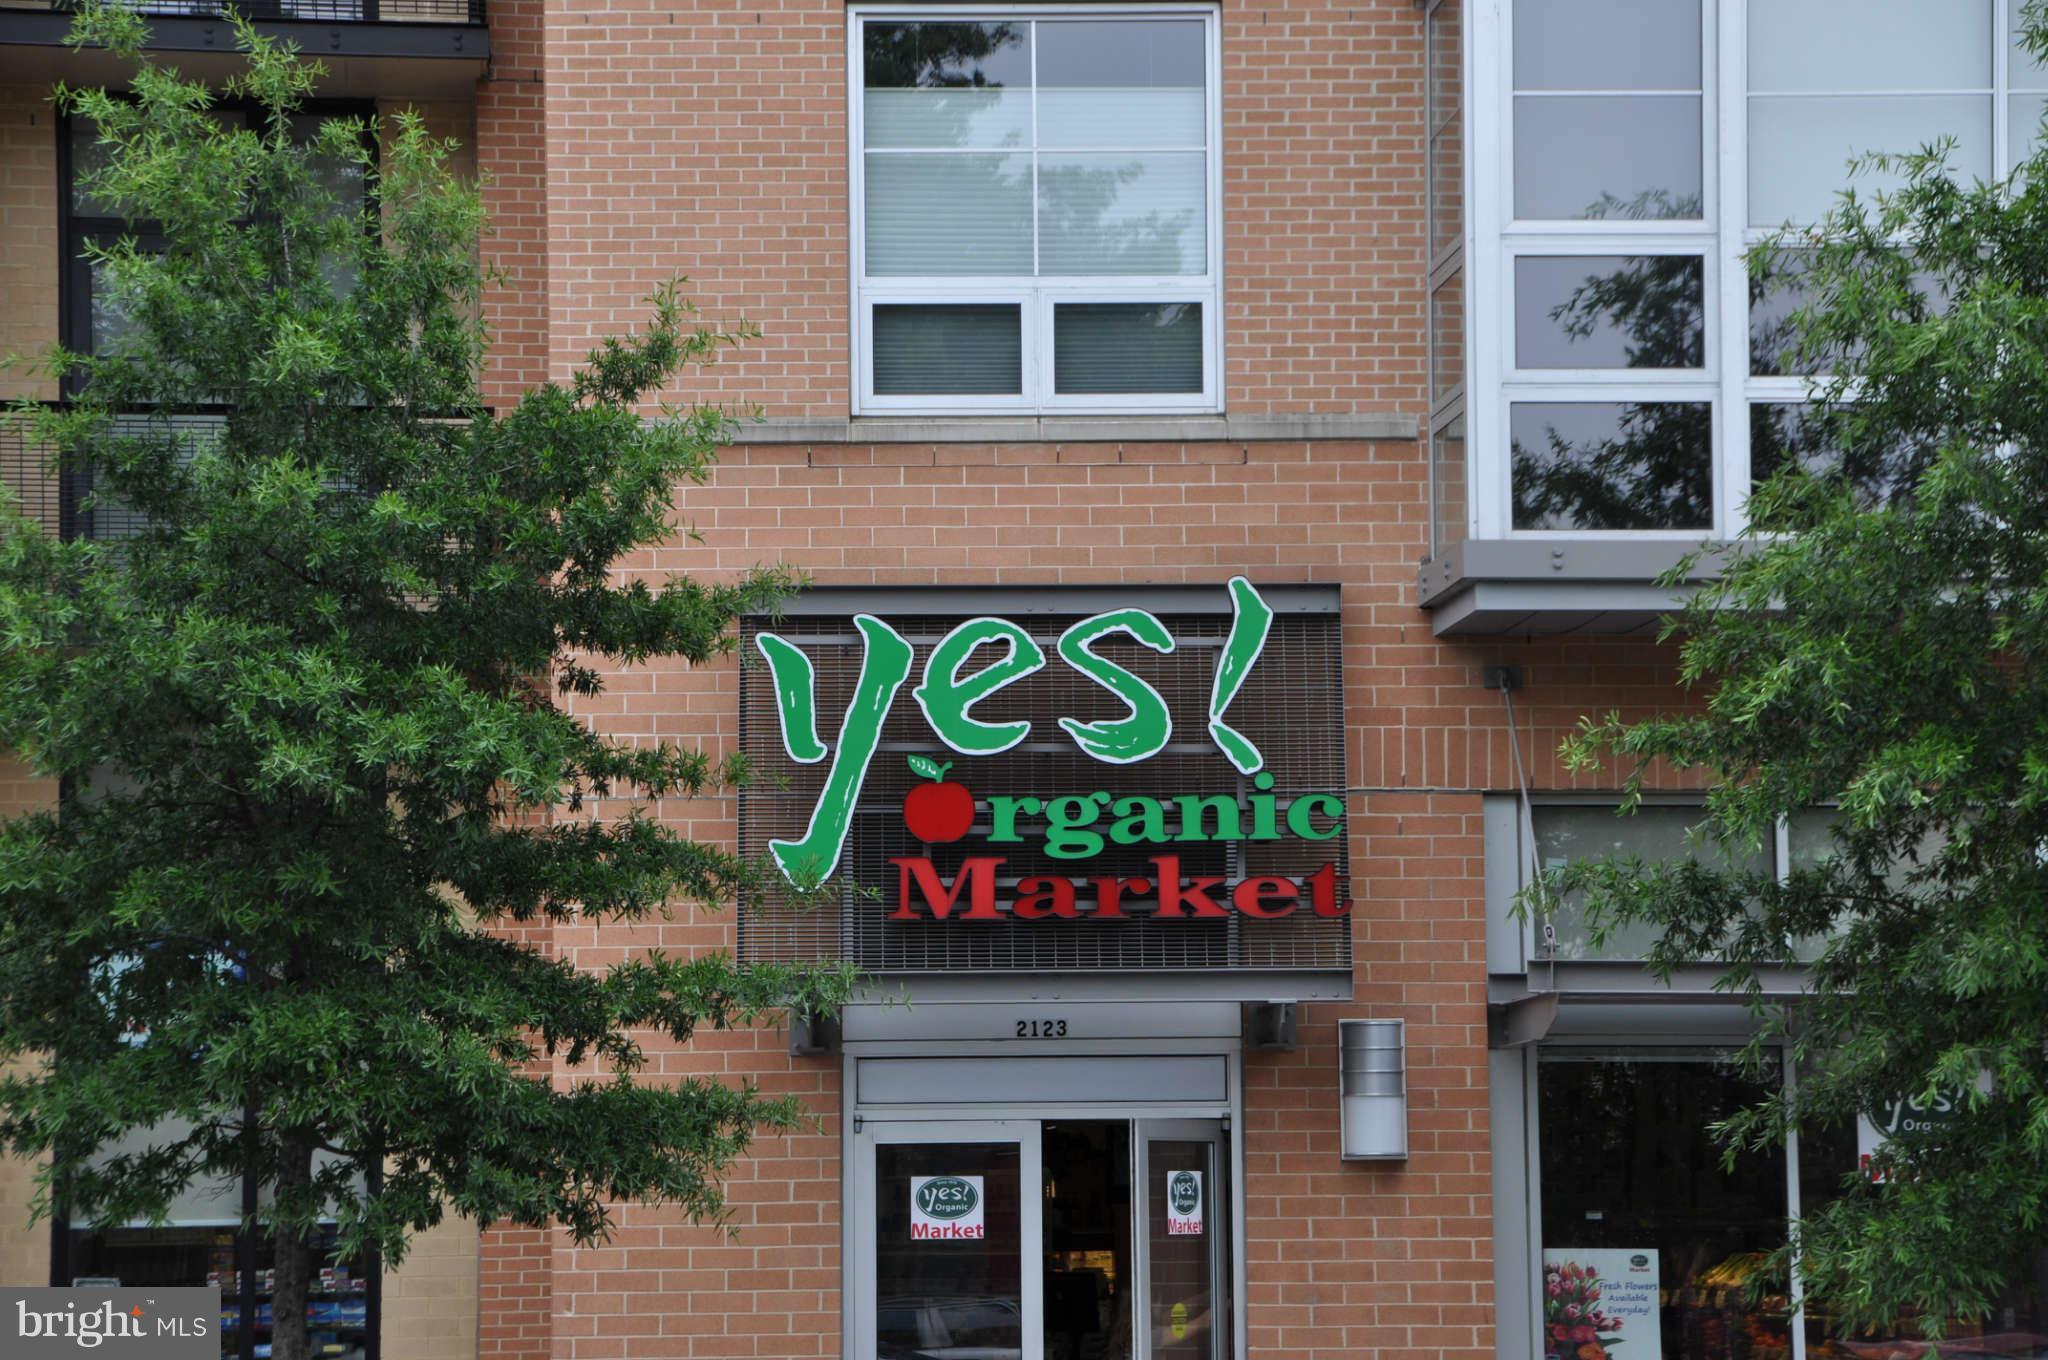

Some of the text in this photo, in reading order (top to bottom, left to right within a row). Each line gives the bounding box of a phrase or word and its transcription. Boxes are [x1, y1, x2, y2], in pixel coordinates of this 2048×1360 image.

[755, 575, 1274, 892] yes!
[887, 854, 1354, 920] Market
[1016, 1020, 1067, 1037] 2123
[923, 1185, 969, 1212] yes!
[935, 1203, 969, 1213] Organic
[911, 1221, 983, 1239] Market
[1168, 1217, 1202, 1233] Market
[1599, 1280, 1658, 1291] Fresh Flowers
[1608, 1293, 1649, 1302] Available
